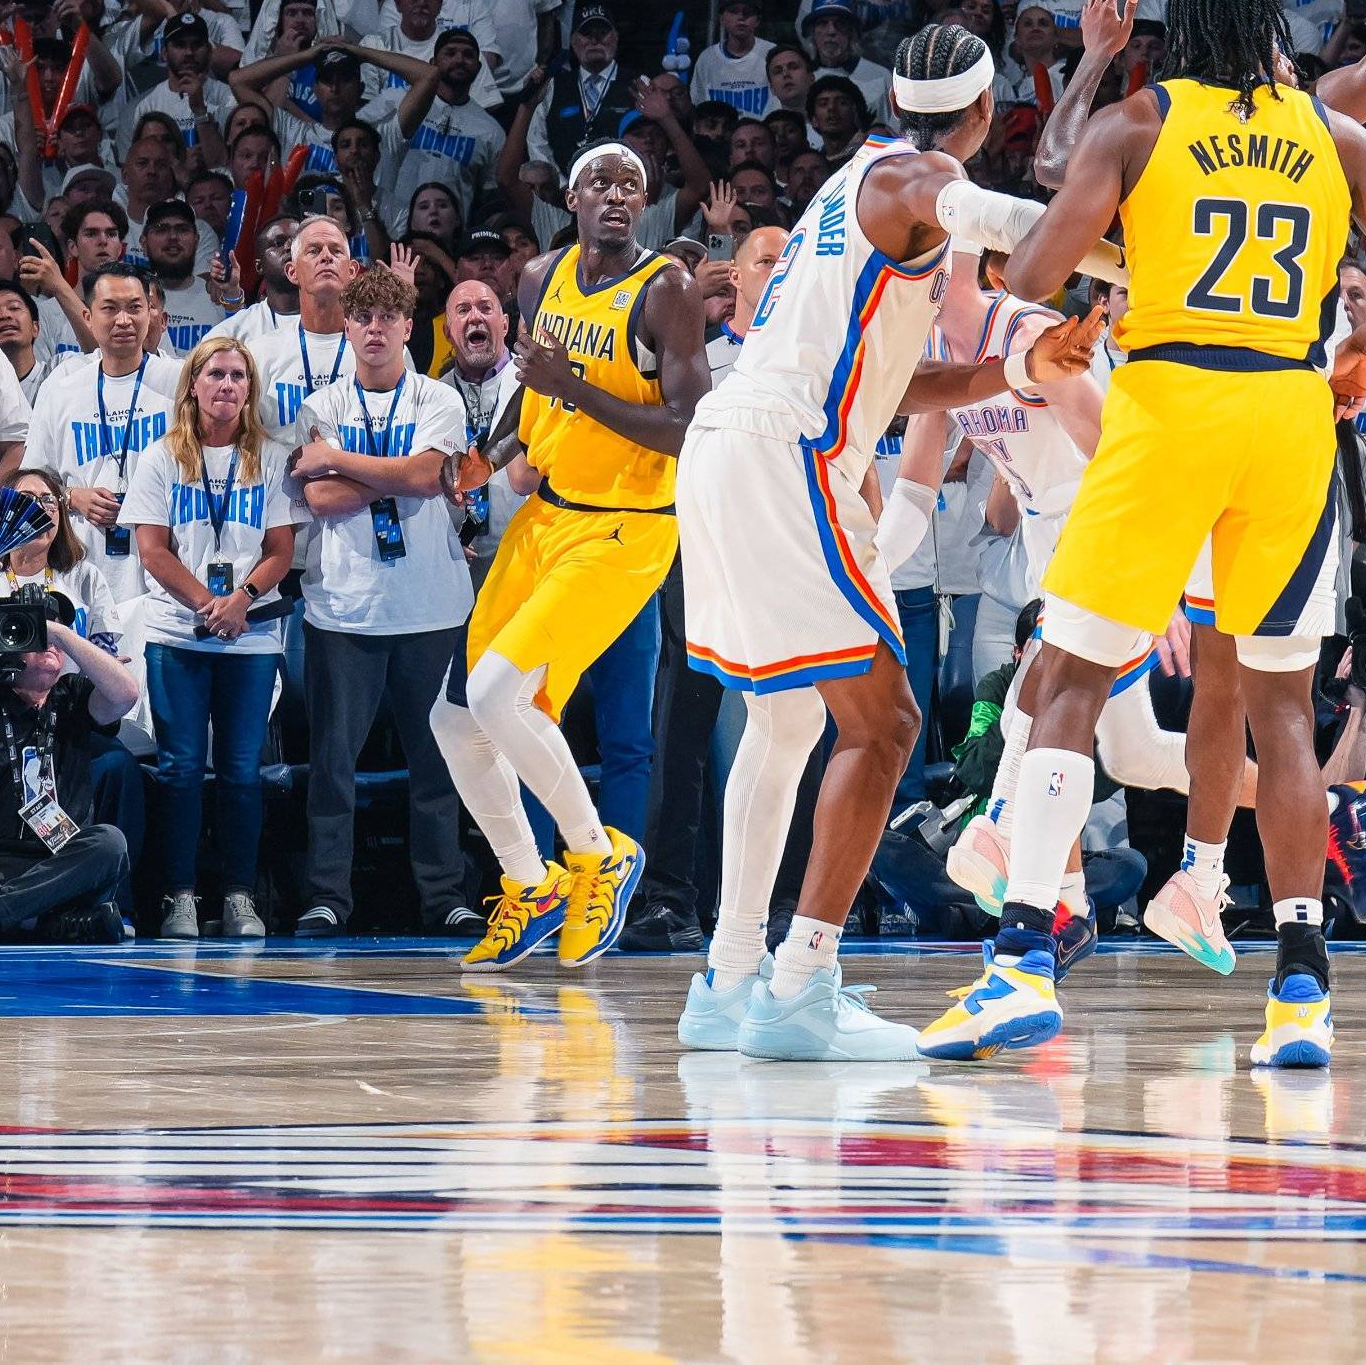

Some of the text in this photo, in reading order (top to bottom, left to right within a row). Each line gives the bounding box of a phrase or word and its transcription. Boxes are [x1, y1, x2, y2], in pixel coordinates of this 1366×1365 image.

[708, 86, 770, 116] THUNDER
[1186, 133, 1316, 185] NESMITH
[1185, 197, 1313, 320] 23
[72, 411, 167, 466] THUNDER
